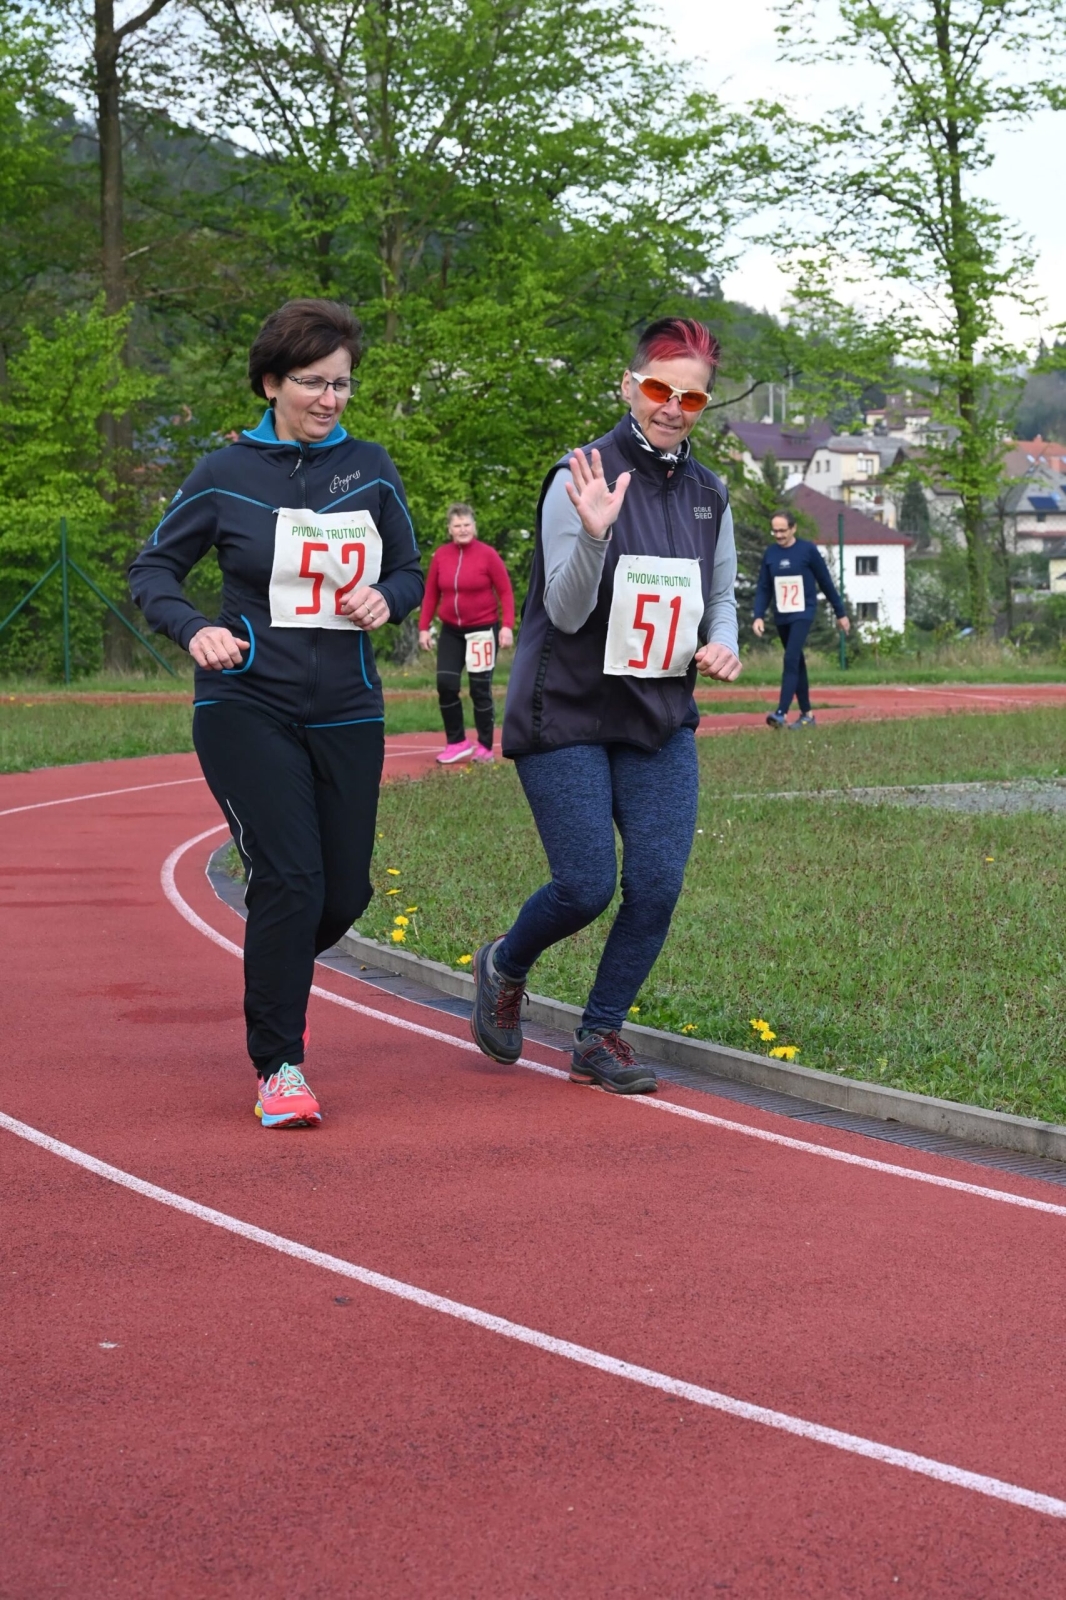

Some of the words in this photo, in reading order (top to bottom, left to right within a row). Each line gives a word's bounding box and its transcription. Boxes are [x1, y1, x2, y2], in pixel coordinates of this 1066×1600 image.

[325, 527, 367, 540] TRUTNOV
[295, 541, 366, 615] 52
[627, 572, 660, 586] PIVOVAR
[660, 575, 691, 587] TRUTNOV
[781, 584, 799, 606] 72
[628, 594, 682, 671] 51
[472, 641, 493, 667] 58
